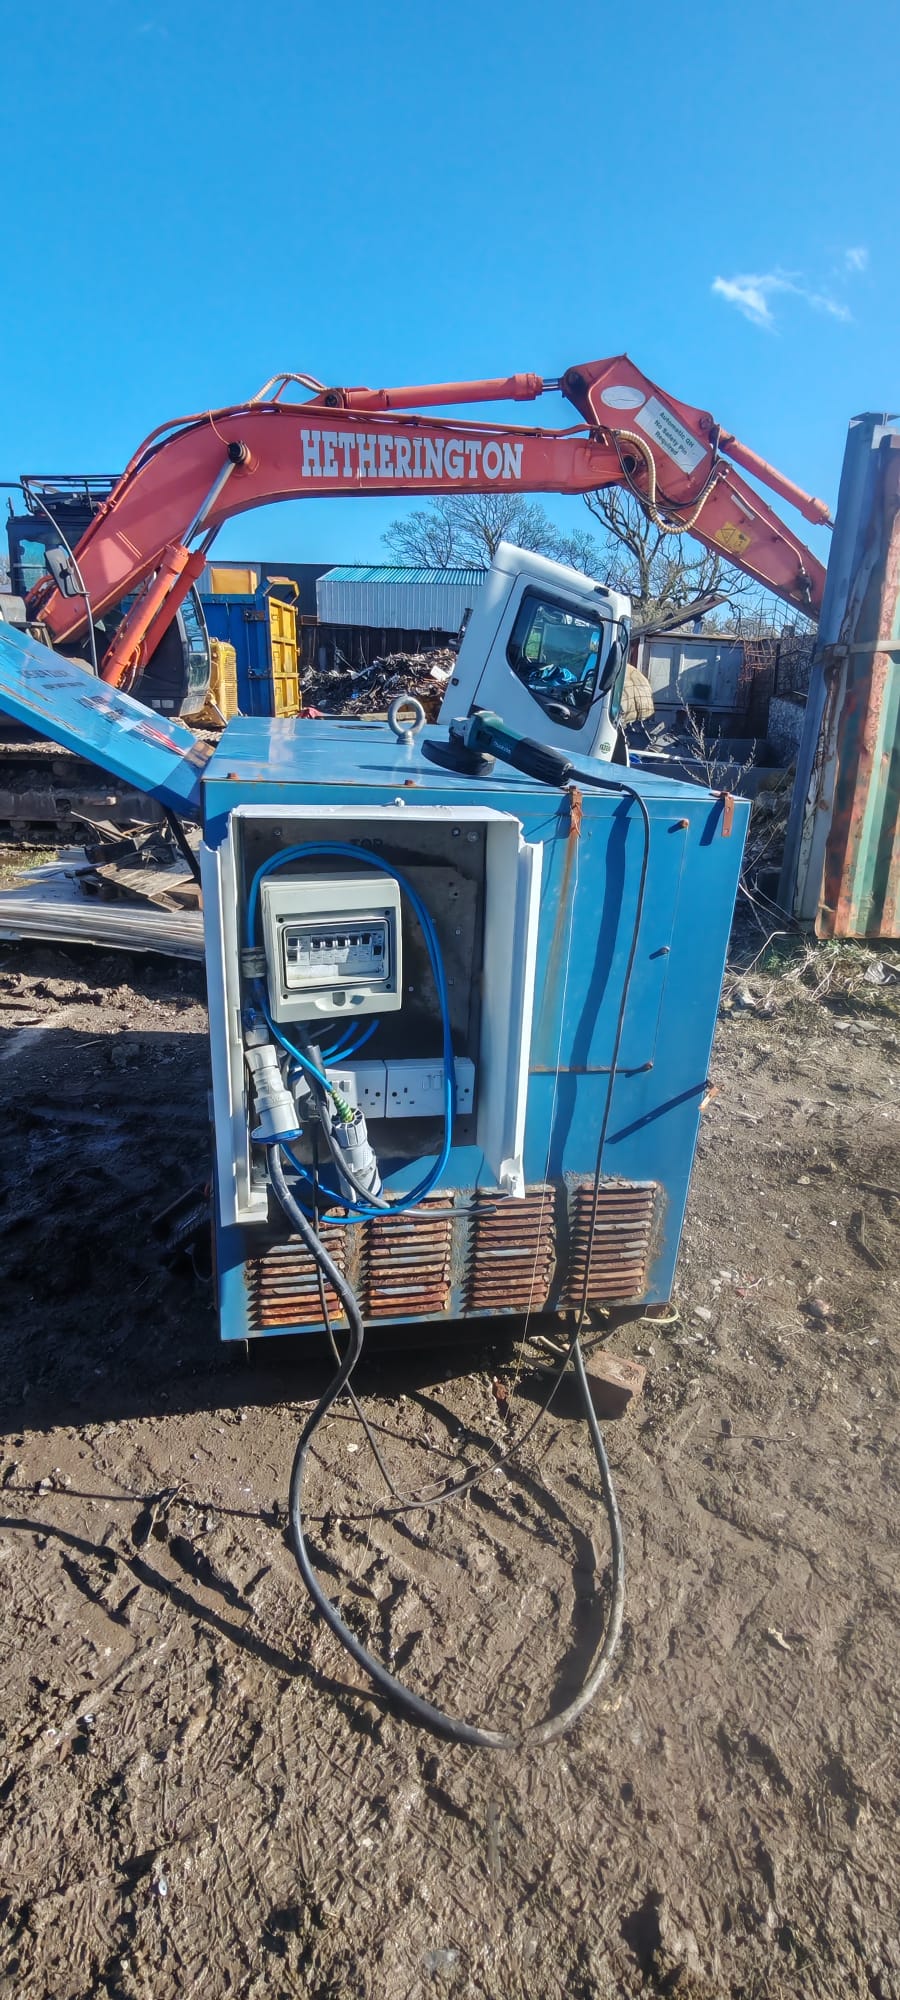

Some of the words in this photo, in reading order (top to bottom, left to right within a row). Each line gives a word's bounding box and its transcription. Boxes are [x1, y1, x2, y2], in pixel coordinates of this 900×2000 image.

[654, 419, 662, 429] No
[662, 428, 678, 447] Safety
[679, 444, 688, 455] Pin
[660, 412, 686, 440] Automatic
[301, 429, 524, 480] HETHERINGTON
[655, 431, 678, 455] Required
